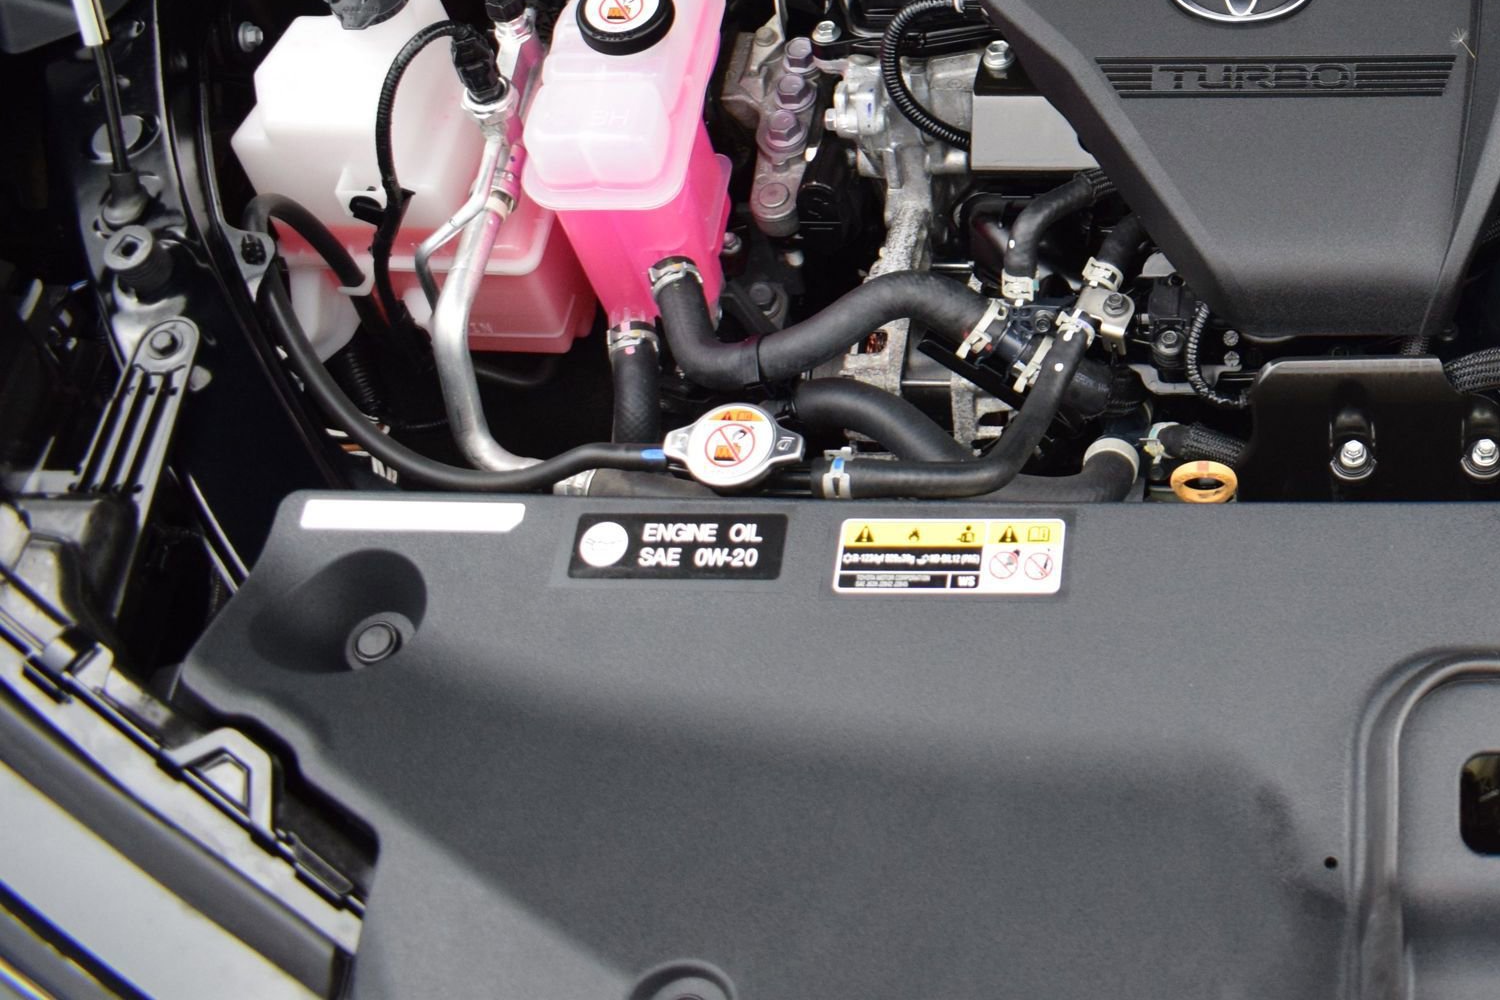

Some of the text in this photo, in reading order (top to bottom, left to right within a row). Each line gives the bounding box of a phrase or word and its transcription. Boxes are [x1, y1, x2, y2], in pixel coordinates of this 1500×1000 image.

[1157, 63, 1350, 91] TURBO
[641, 523, 764, 543] ENGINE OIL
[637, 546, 759, 568] SAE 0W-20
